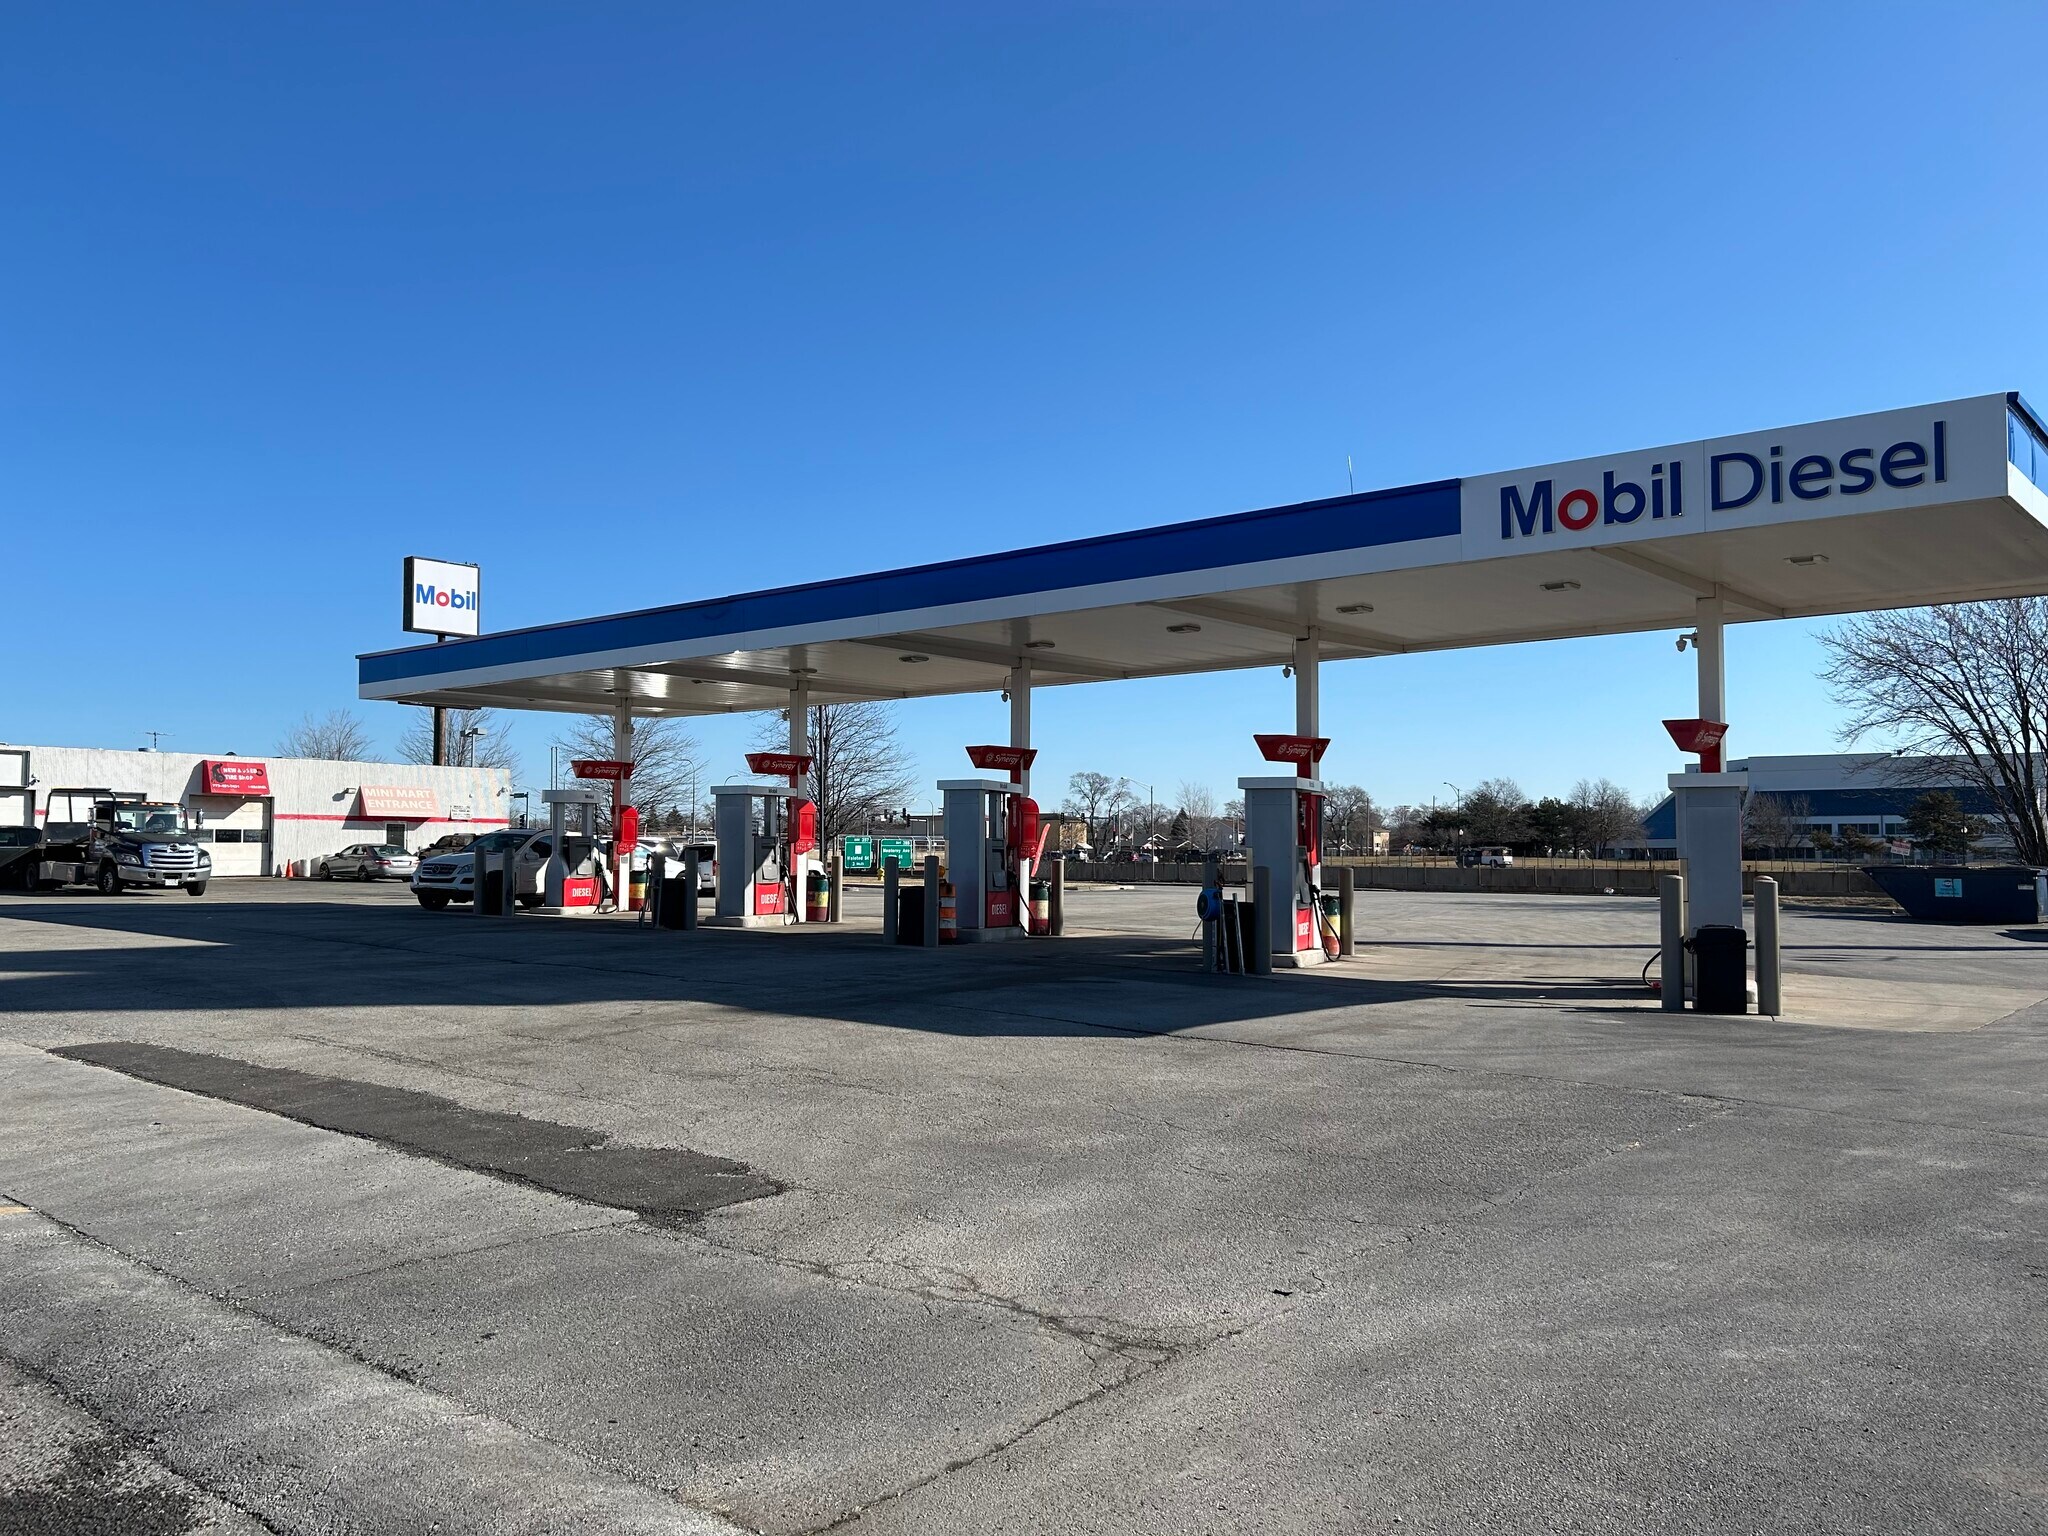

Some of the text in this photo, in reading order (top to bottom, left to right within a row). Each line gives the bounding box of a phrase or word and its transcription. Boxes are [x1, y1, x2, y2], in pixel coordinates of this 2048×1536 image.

[1500, 420, 1947, 541] Mobil Diesel
[416, 583, 476, 611] Mobil
[1286, 745, 1310, 757] Synergy
[994, 754, 1020, 765] Synergy
[594, 767, 619, 775] Synergy
[771, 760, 796, 771] Synergy
[364, 787, 431, 799] MINI MART
[368, 799, 433, 810] ENTRANCE
[572, 887, 593, 898] DIESEL
[991, 903, 1008, 915] DIESEL
